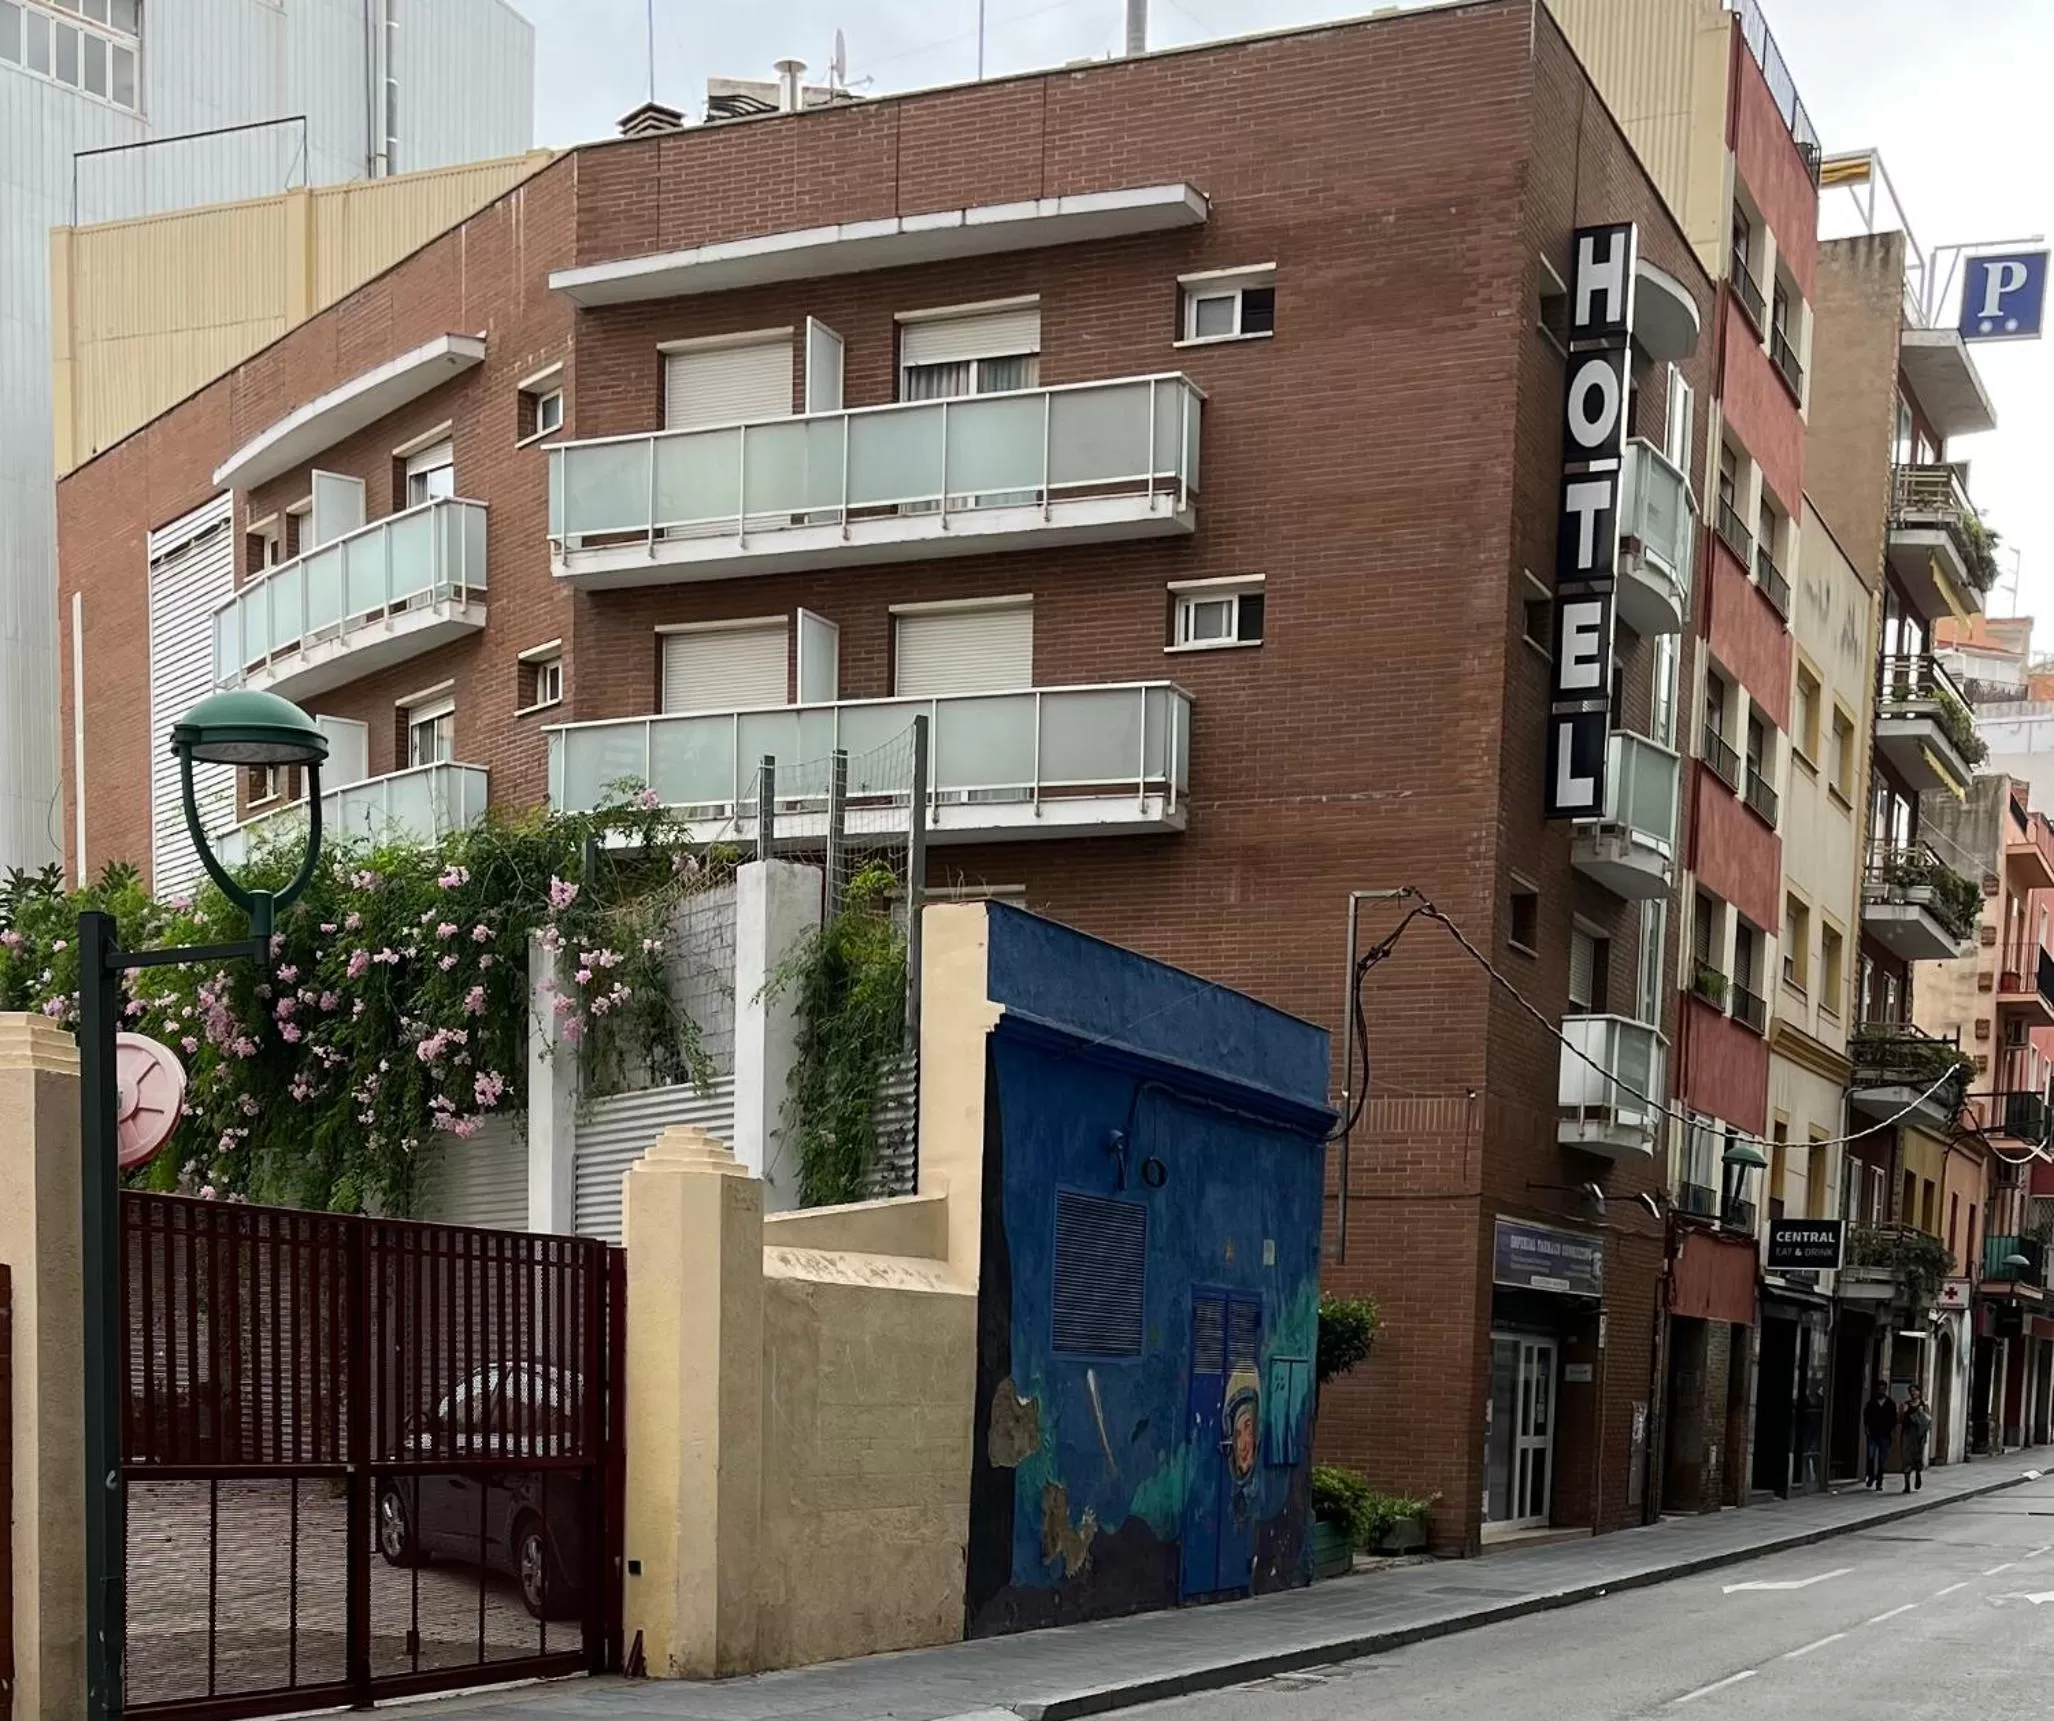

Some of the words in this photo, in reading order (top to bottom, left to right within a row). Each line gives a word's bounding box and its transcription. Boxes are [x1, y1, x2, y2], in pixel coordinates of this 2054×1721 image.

[1977, 261, 2028, 317] P
[1556, 231, 1625, 808] HOTEL
[1775, 1231, 1836, 1243] CENTRAL
[1775, 1247, 1793, 1257] EAT
[1794, 1247, 1802, 1257] &
[1804, 1247, 1834, 1257] DRINK
